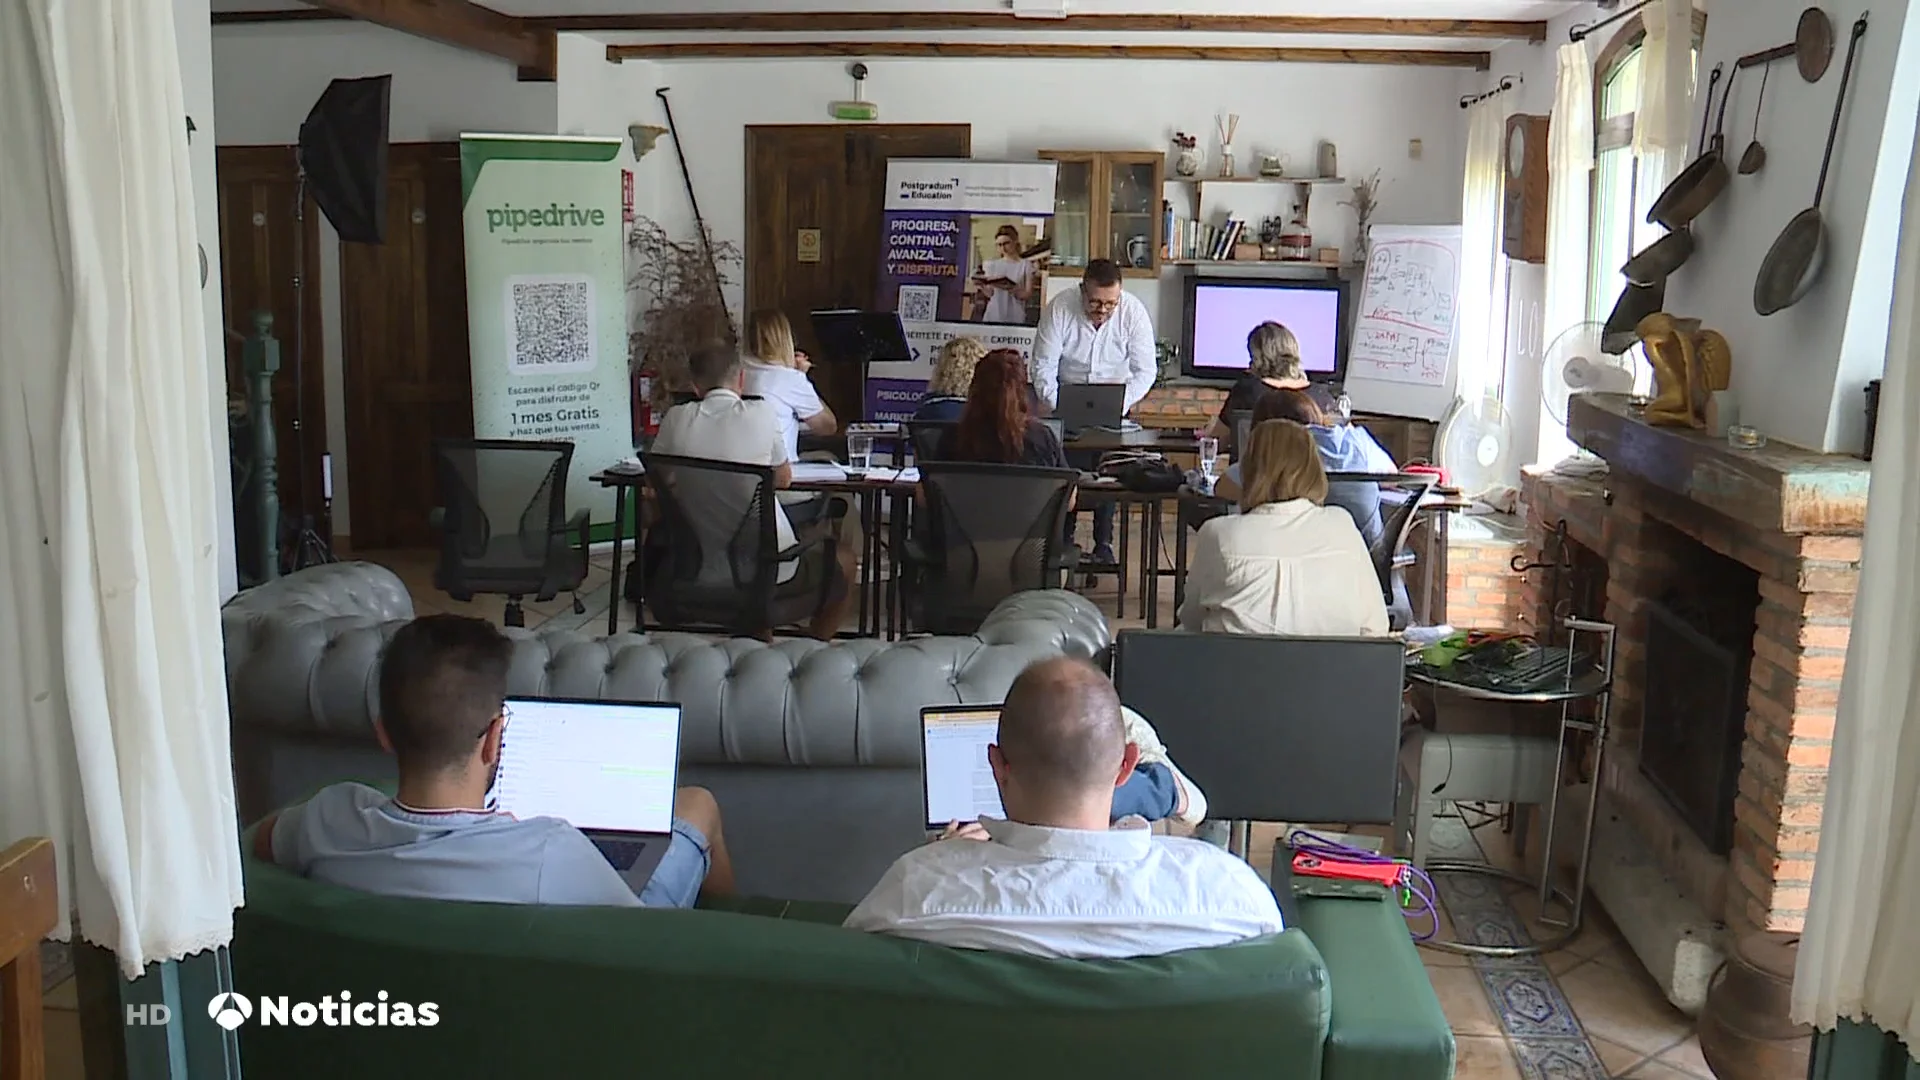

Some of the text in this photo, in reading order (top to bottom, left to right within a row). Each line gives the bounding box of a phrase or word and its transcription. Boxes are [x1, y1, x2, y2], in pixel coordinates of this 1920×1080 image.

[900, 181, 953, 191] Postgradum
[911, 191, 952, 200] Education
[486, 203, 605, 233] pipedrive
[891, 220, 960, 233] PROGRESA,
[890, 233, 955, 247] CONTINÚA,
[888, 248, 945, 261] AVANZA...
[887, 264, 959, 277] Y DISFRUTA!
[990, 335, 1032, 346] EXPERTO
[508, 386, 545, 396] Escanea
[546, 384, 555, 393] el
[515, 393, 591, 407] para disfrutar de
[511, 406, 600, 425] 1 mes Gratis
[509, 422, 601, 438] y haz que tus ventas
